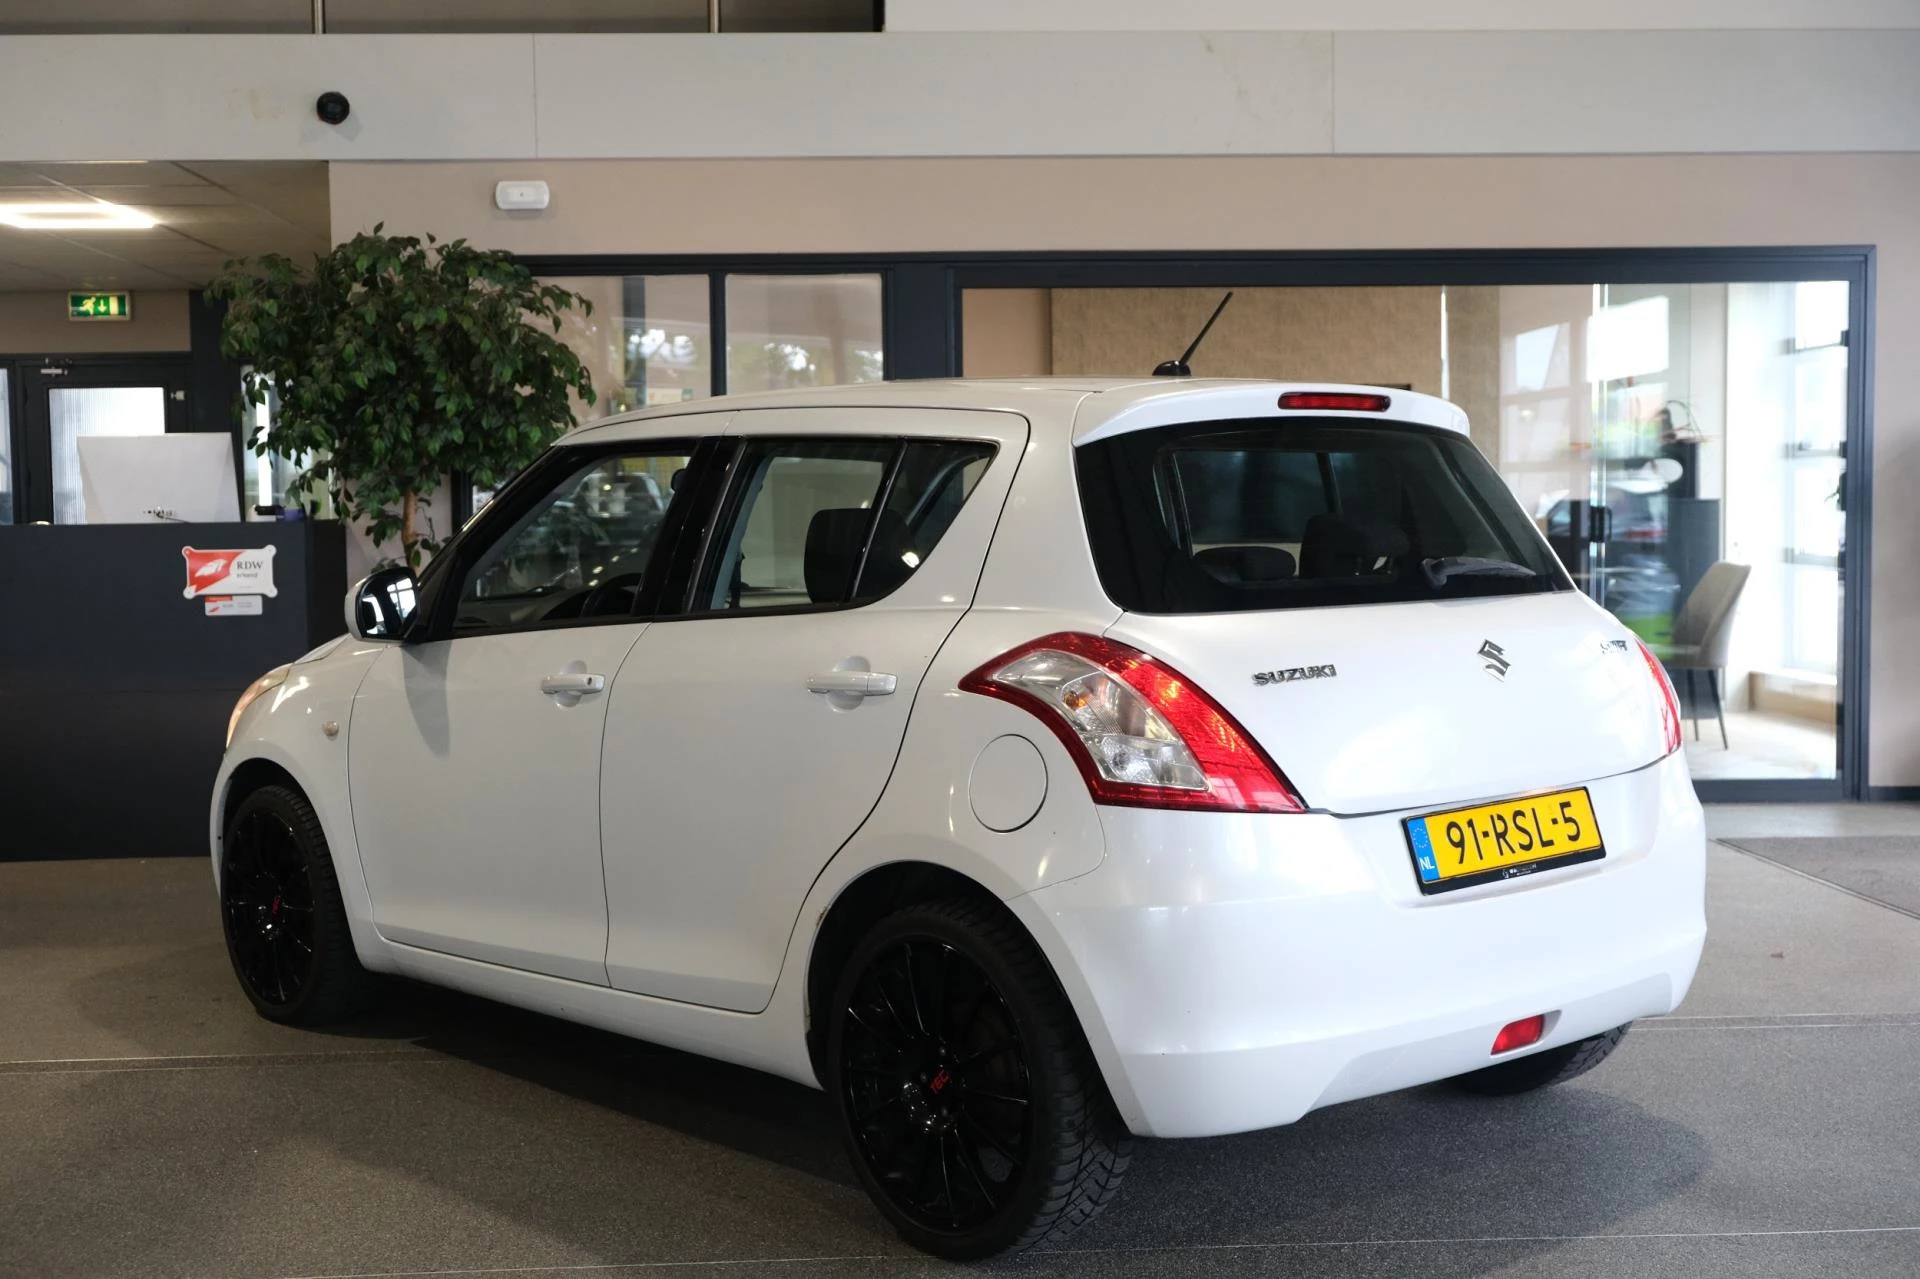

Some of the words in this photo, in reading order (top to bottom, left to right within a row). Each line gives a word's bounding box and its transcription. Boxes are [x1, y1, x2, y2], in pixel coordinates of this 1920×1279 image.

[236, 560, 263, 570] RDW
[1252, 664, 1337, 686] SUZUKI
[1446, 801, 1581, 864] 91-RSL-5
[1419, 855, 1435, 871] NL
